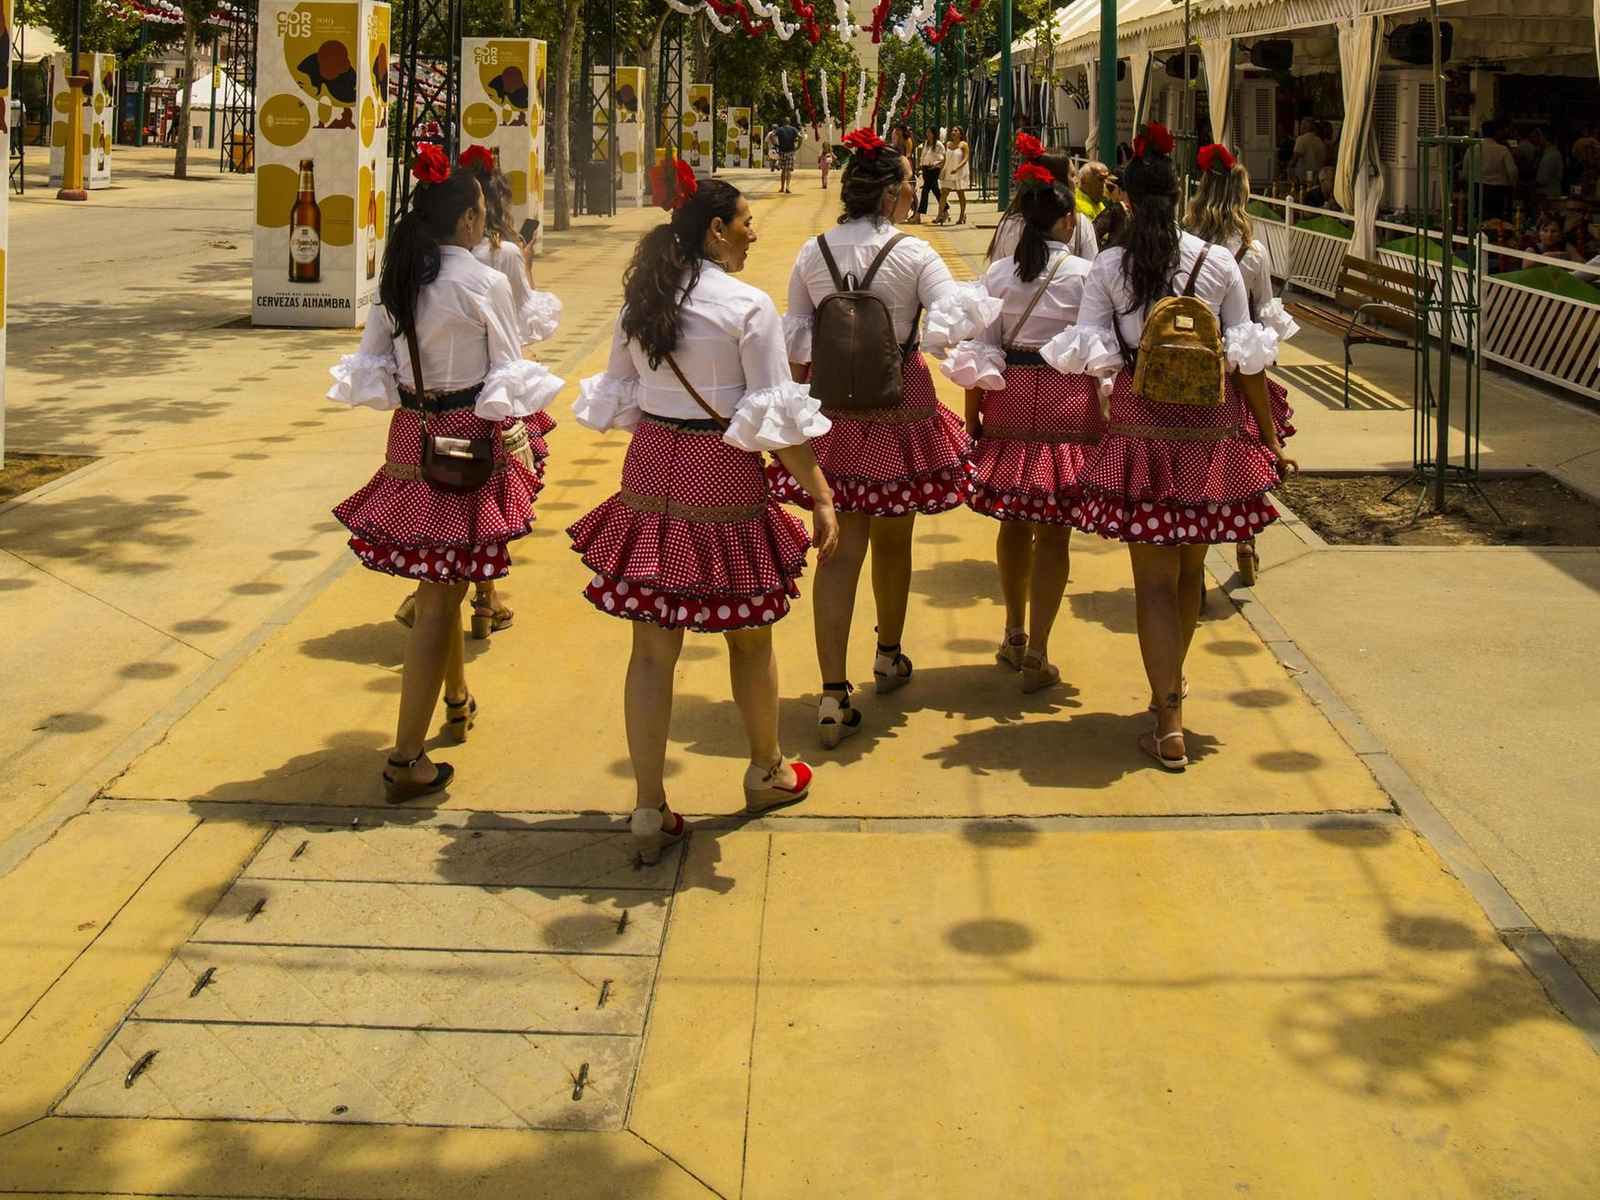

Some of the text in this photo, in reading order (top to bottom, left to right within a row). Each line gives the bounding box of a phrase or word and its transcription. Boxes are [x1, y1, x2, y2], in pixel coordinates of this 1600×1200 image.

[277, 11, 312, 24] COR
[277, 24, 312, 38] PUS
[474, 46, 498, 56] COR
[474, 56, 498, 65] PUS
[257, 296, 299, 308] CERVEZAS
[302, 297, 351, 310] ALHAMBRA
